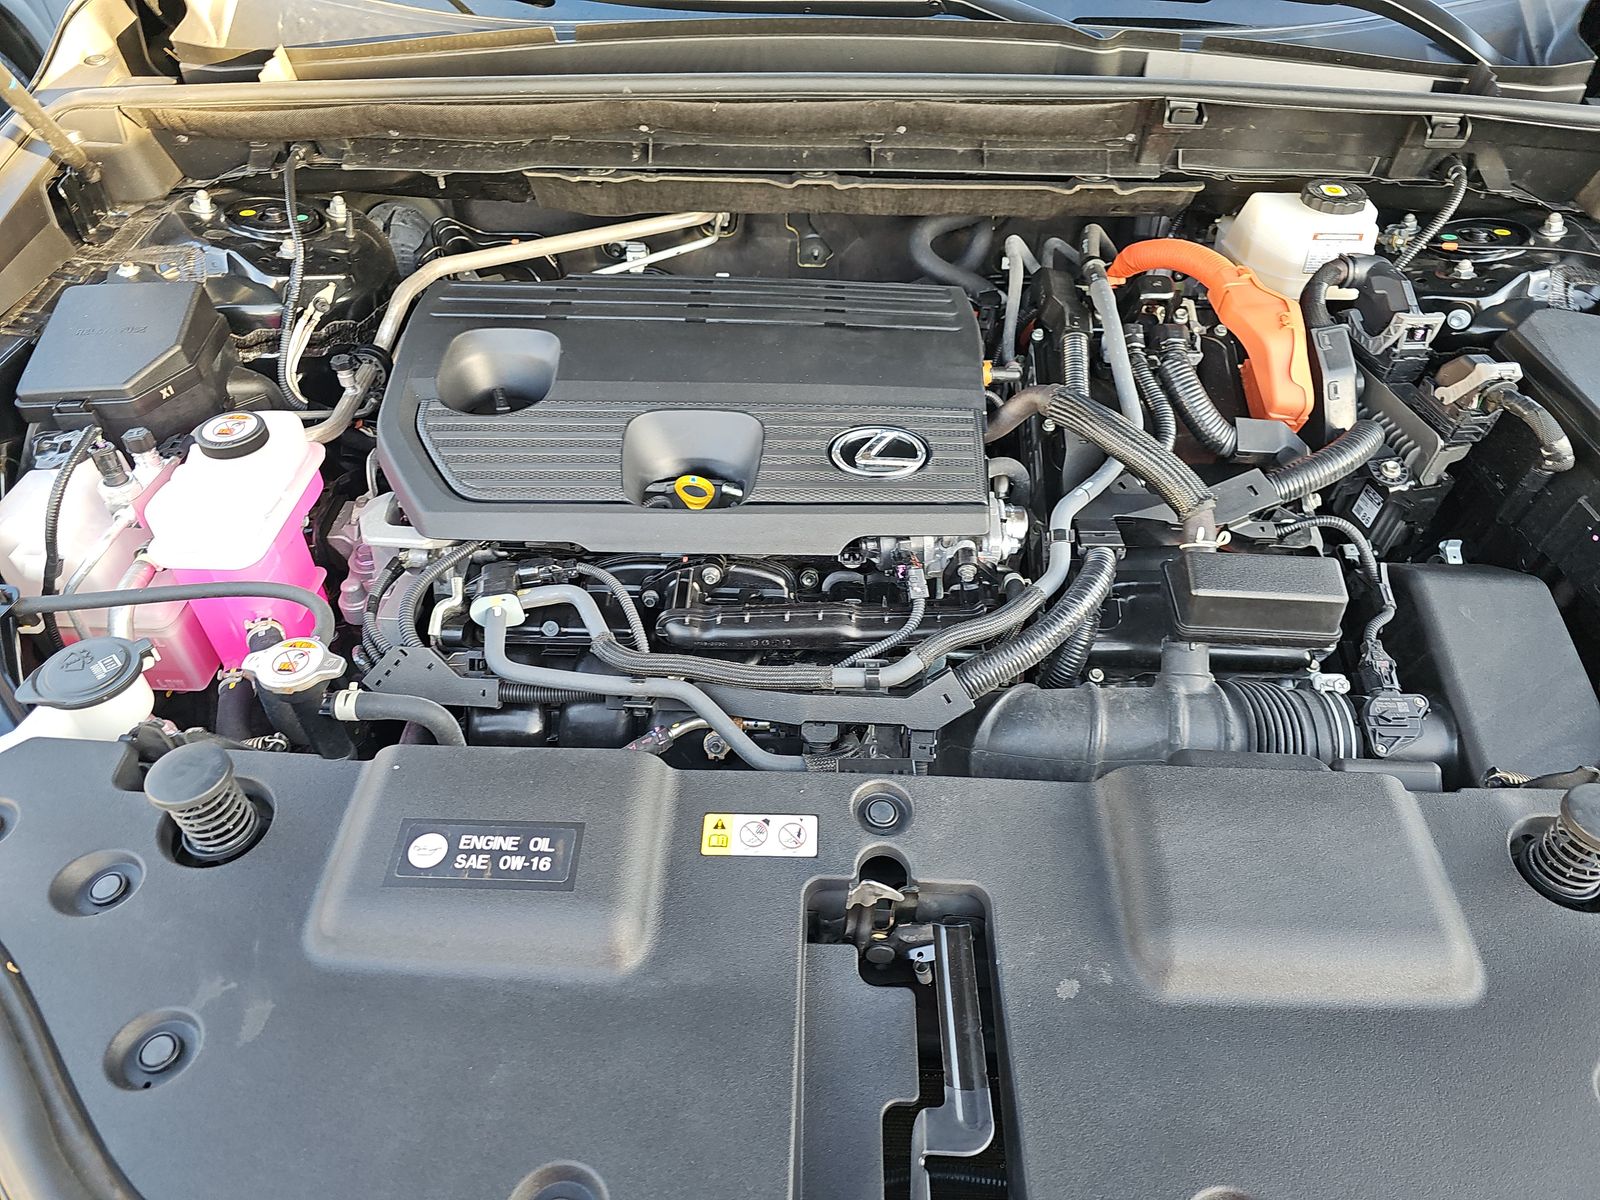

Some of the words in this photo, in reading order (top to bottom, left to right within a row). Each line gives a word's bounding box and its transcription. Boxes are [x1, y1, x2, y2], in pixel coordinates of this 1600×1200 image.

[458, 834, 521, 851] ENGINE
[528, 837, 555, 852] OIL
[453, 853, 490, 869] SAE
